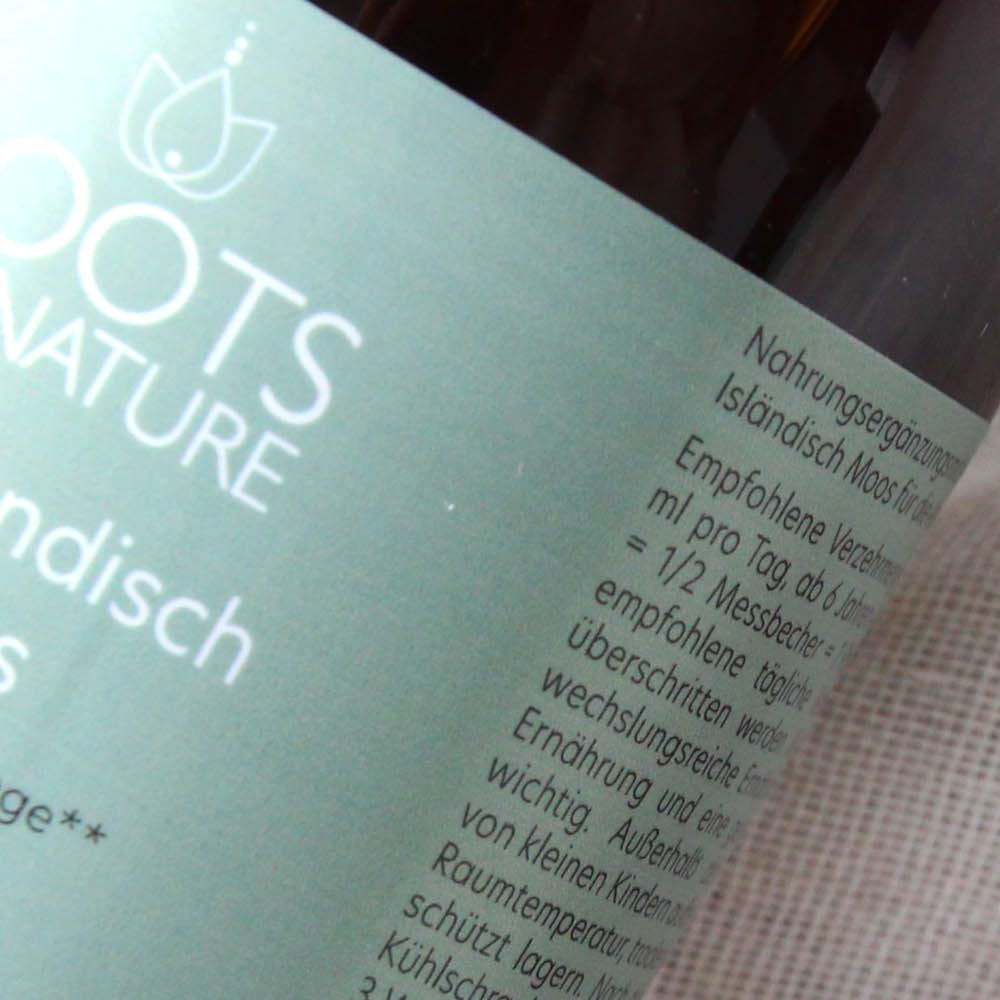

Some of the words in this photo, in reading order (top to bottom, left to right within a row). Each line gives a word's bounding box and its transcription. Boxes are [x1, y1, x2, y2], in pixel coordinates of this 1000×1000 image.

[675, 435, 826, 545] Empfohlene
[715, 372, 843, 474] Isländisch
[844, 451, 893, 505] Moos
[627, 533, 647, 554] =
[658, 546, 706, 595] 1/2
[706, 574, 825, 661] Messbecher
[647, 485, 692, 525] ml
[688, 511, 740, 556] pro
[748, 533, 791, 592] Tag,
[795, 569, 826, 603] ab
[822, 584, 838, 613] 6
[567, 617, 730, 728] überschritten
[595, 578, 746, 679] empfohlene
[512, 705, 653, 809] Ernährung
[656, 785, 703, 824] und
[541, 667, 741, 788] wechslungsreiche
[460, 801, 516, 848] von
[517, 825, 607, 895] kleinen
[607, 868, 673, 920] Kindern
[487, 756, 592, 836] wichtig.
[608, 817, 704, 881] Außerhalb
[403, 894, 511, 963] schützt
[513, 938, 583, 998] lagern.
[432, 840, 629, 962] Raumtemperatur,
